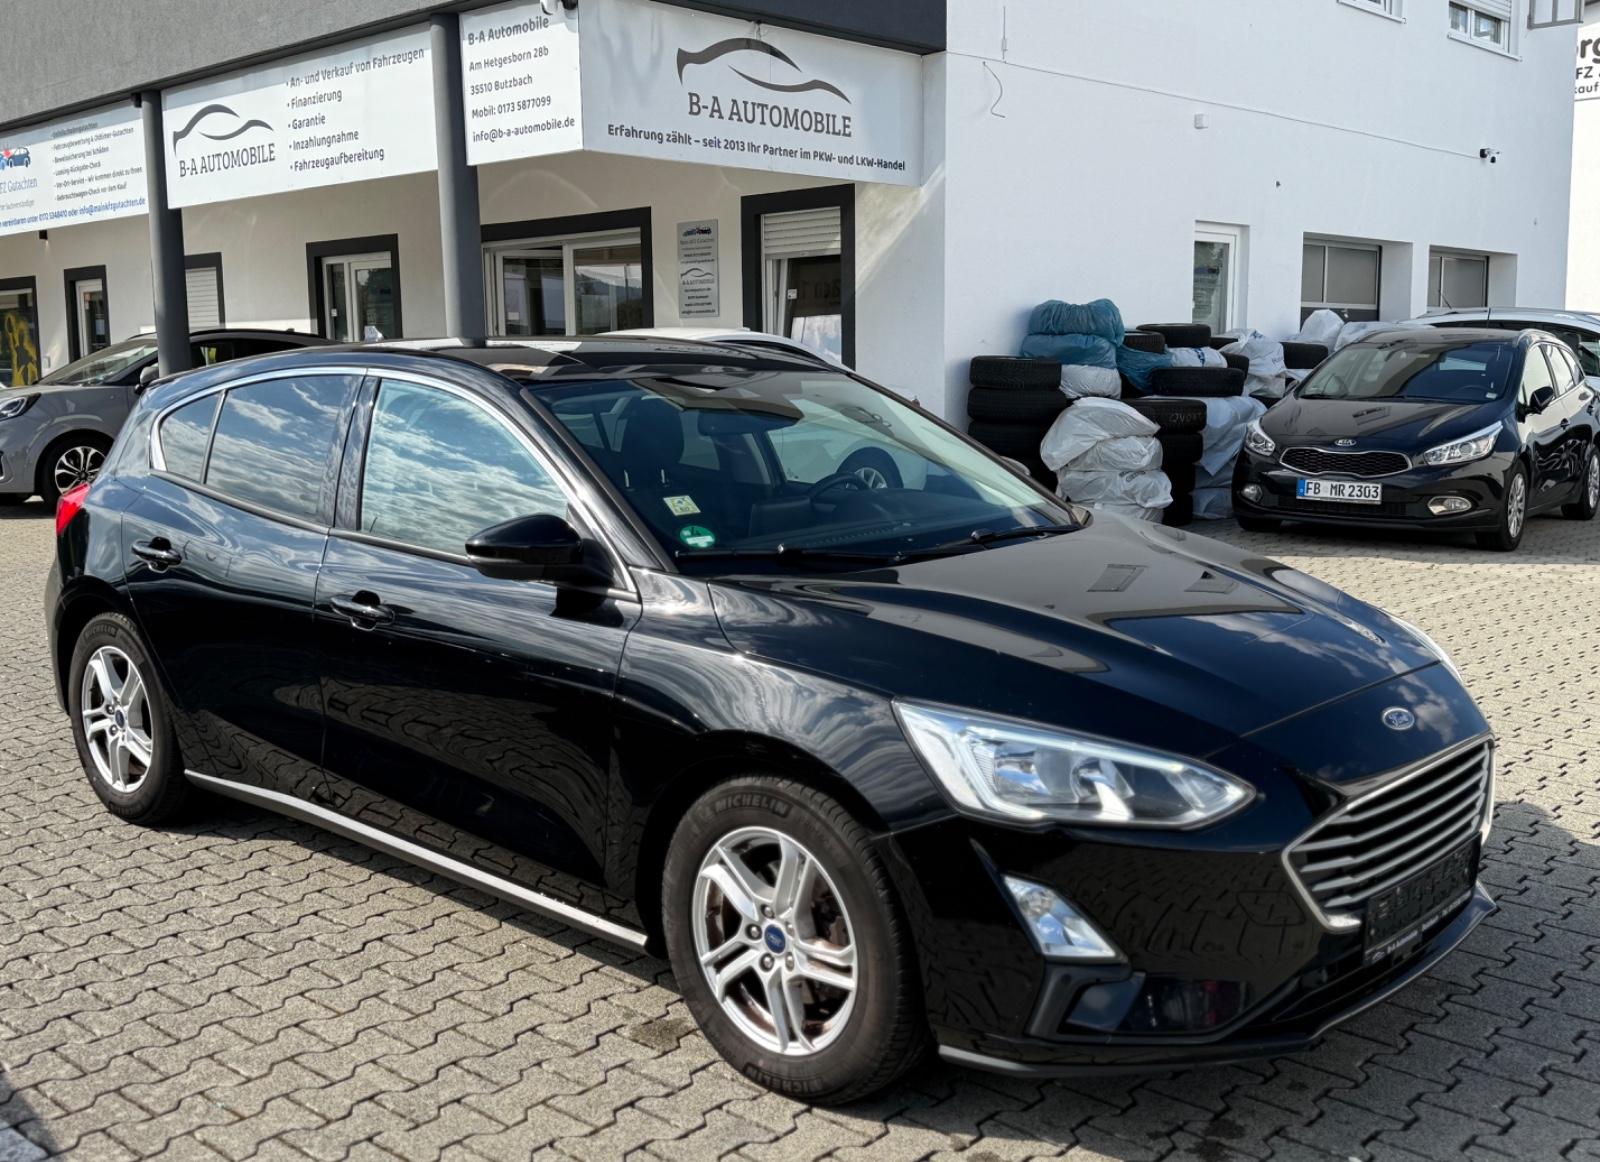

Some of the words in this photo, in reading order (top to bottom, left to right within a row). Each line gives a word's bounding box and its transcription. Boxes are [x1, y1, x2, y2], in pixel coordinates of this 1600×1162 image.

[468, 32, 485, 45] B-A
[488, 16, 549, 42] Automobile
[289, 75, 304, 89] An-
[304, 71, 320, 85] und
[321, 62, 354, 81] Verkauf
[355, 60, 371, 74] von
[372, 48, 425, 71] Fahrzeugen
[469, 61, 482, 72] Am
[483, 50, 532, 68] Hetgesborn
[533, 46, 549, 58] 28b
[470, 82, 493, 96] 35510
[494, 74, 533, 91] Butzbach
[291, 88, 343, 110] Finanzierung
[472, 106, 496, 119] Mobil:
[497, 103, 515, 114] 0173
[517, 96, 552, 111] 5877099
[292, 113, 326, 130] Garantie
[687, 91, 724, 120] B-A
[728, 98, 853, 138] AUTOMOBILE
[293, 130, 359, 151] Inzahlungnahme
[473, 117, 575, 143] info@b-a-automobile.de
[294, 147, 385, 172] Fahrzeugaufbereitung
[607, 123, 664, 145] Erfahrung
[666, 130, 692, 146] zählt
[702, 135, 722, 149] seit
[723, 139, 745, 152] 2013
[747, 141, 762, 154] Ihr
[763, 144, 798, 159] Partner
[800, 148, 811, 160] im
[812, 150, 836, 163] PKW-
[837, 153, 854, 166] und
[856, 155, 905, 171] LKW-Handel
[179, 158, 199, 178] B-A
[200, 143, 276, 174] AUTOMOBILE
[1306, 481, 1321, 496] FB
[1330, 483, 1345, 497] MR
[1348, 484, 1380, 498] 2303
[715, 793, 790, 815] MICHELIN
